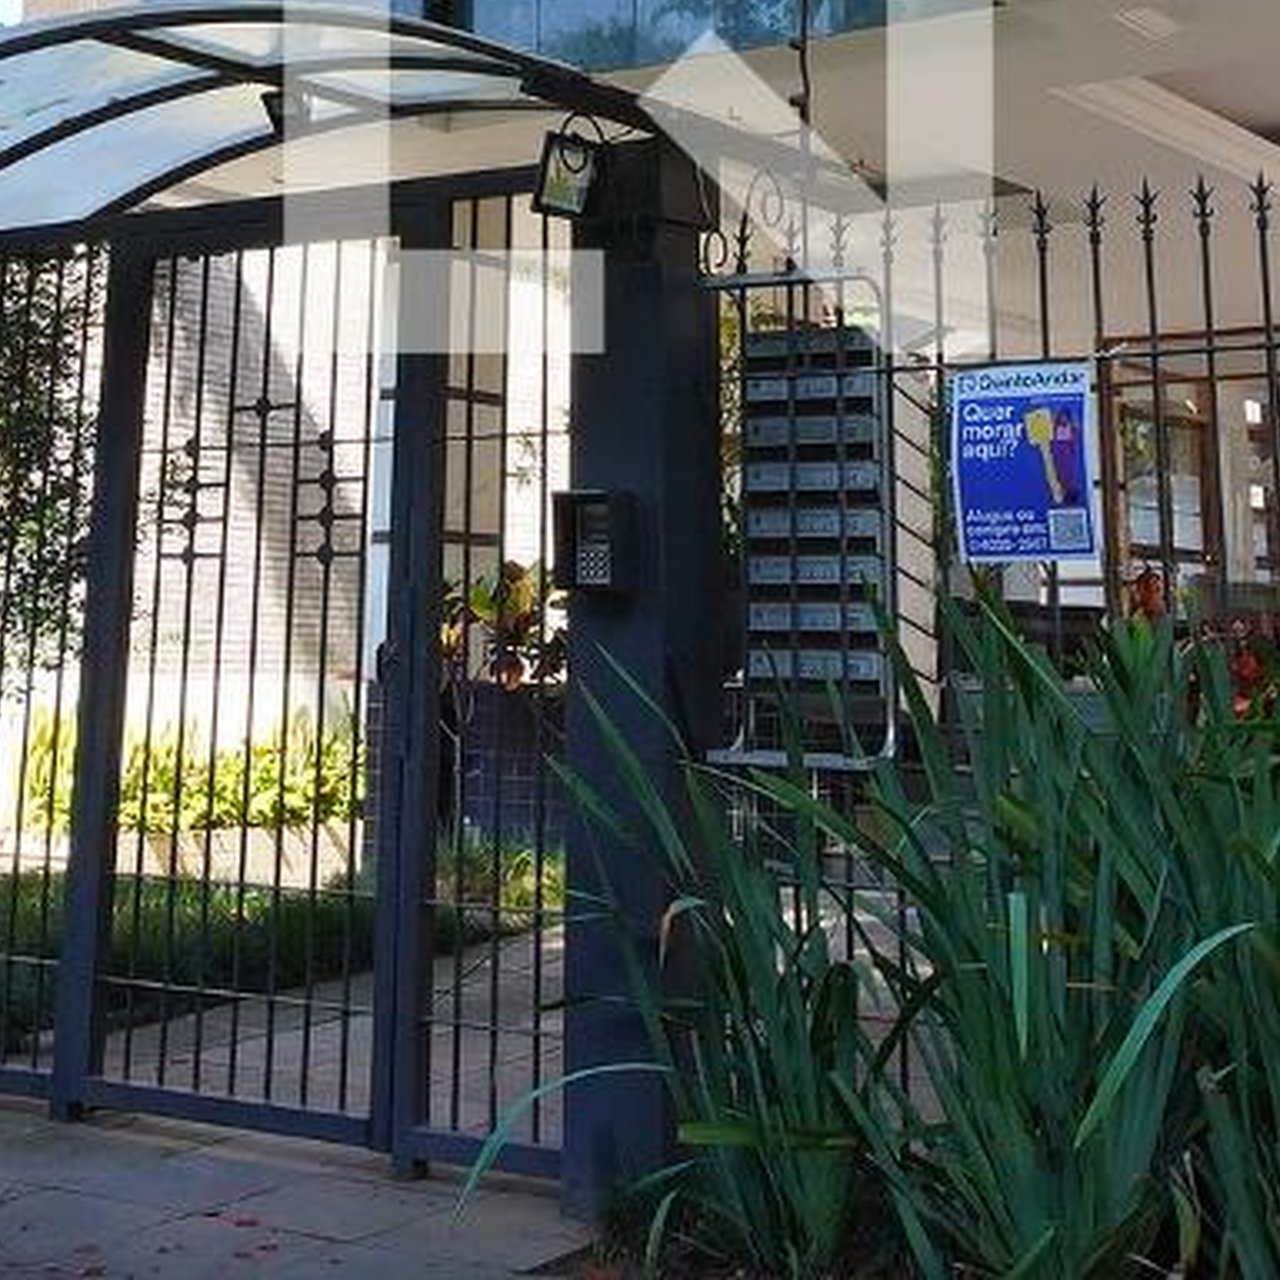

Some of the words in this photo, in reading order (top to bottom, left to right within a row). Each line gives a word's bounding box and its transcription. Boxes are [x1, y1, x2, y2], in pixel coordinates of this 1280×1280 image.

[963, 403, 1015, 422] Quer
[963, 423, 1024, 440] morar
[963, 439, 1018, 462] aqui?
